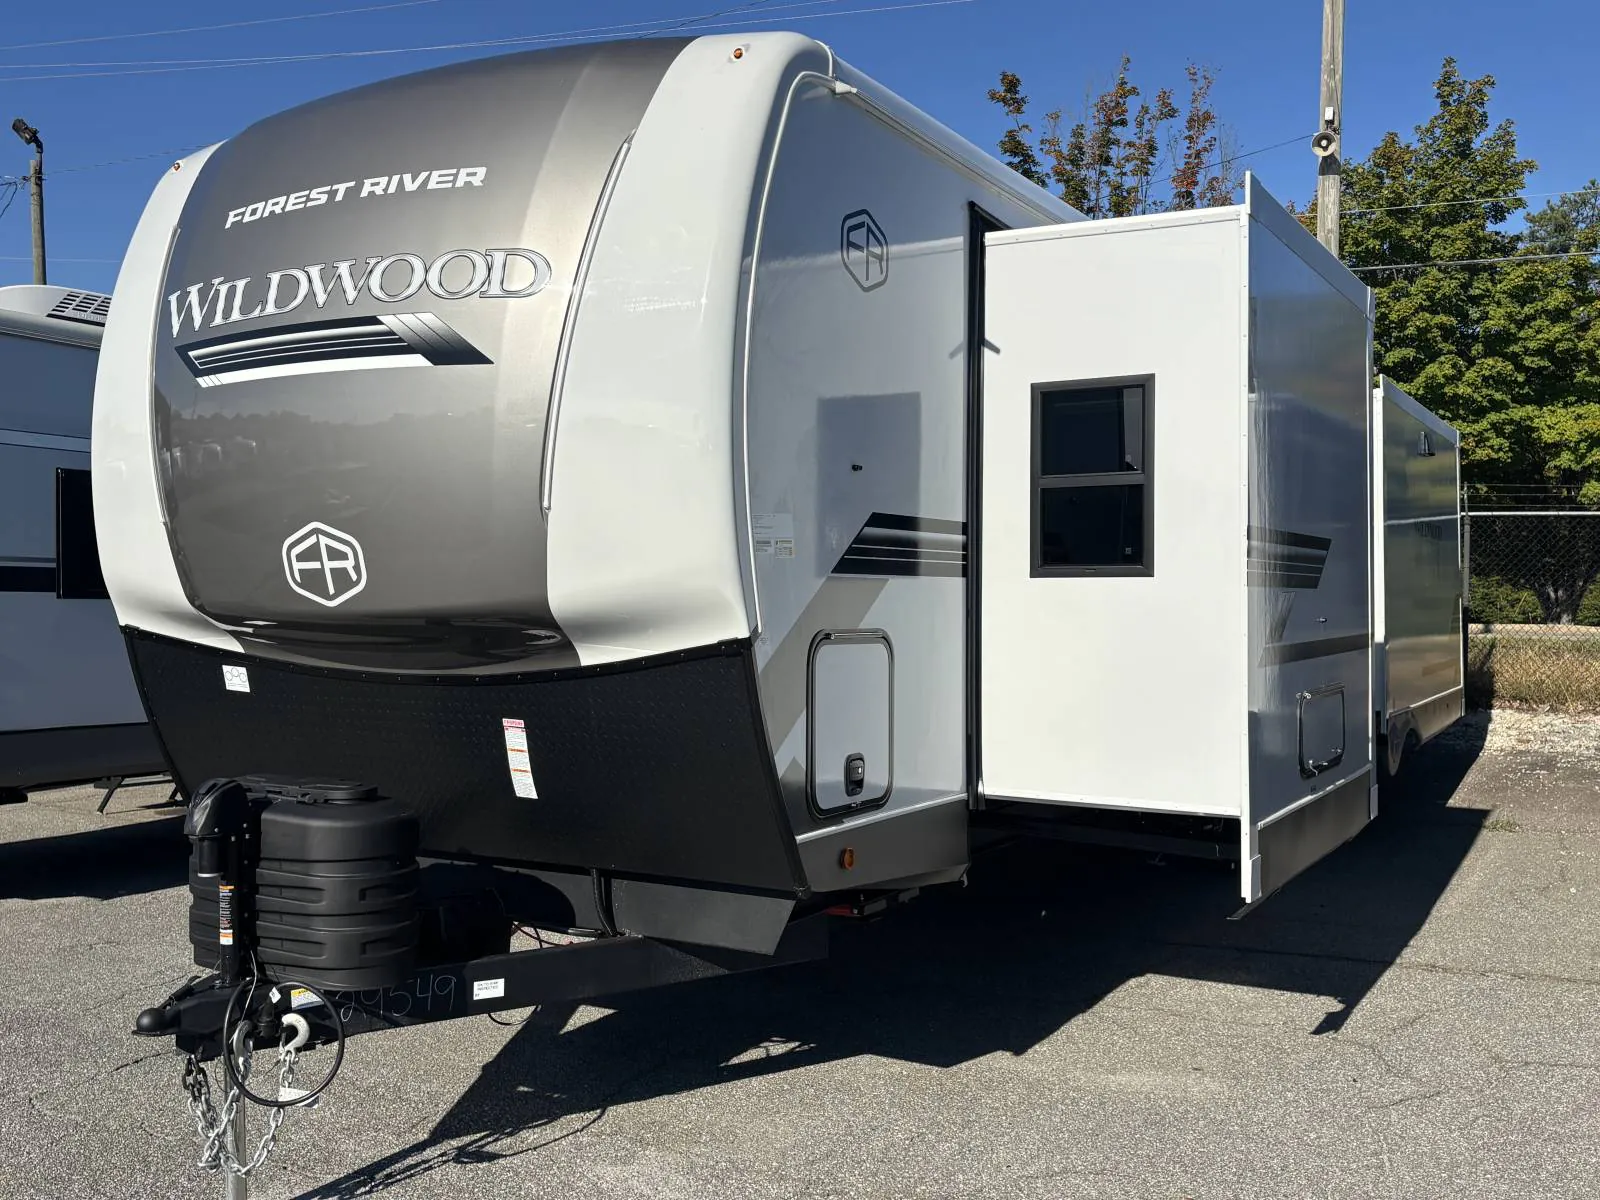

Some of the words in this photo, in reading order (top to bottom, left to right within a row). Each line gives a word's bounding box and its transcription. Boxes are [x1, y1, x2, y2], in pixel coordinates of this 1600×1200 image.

[225, 181, 355, 229] FOREST
[359, 166, 488, 198] RIVER
[167, 247, 552, 338] WILDWOOD
